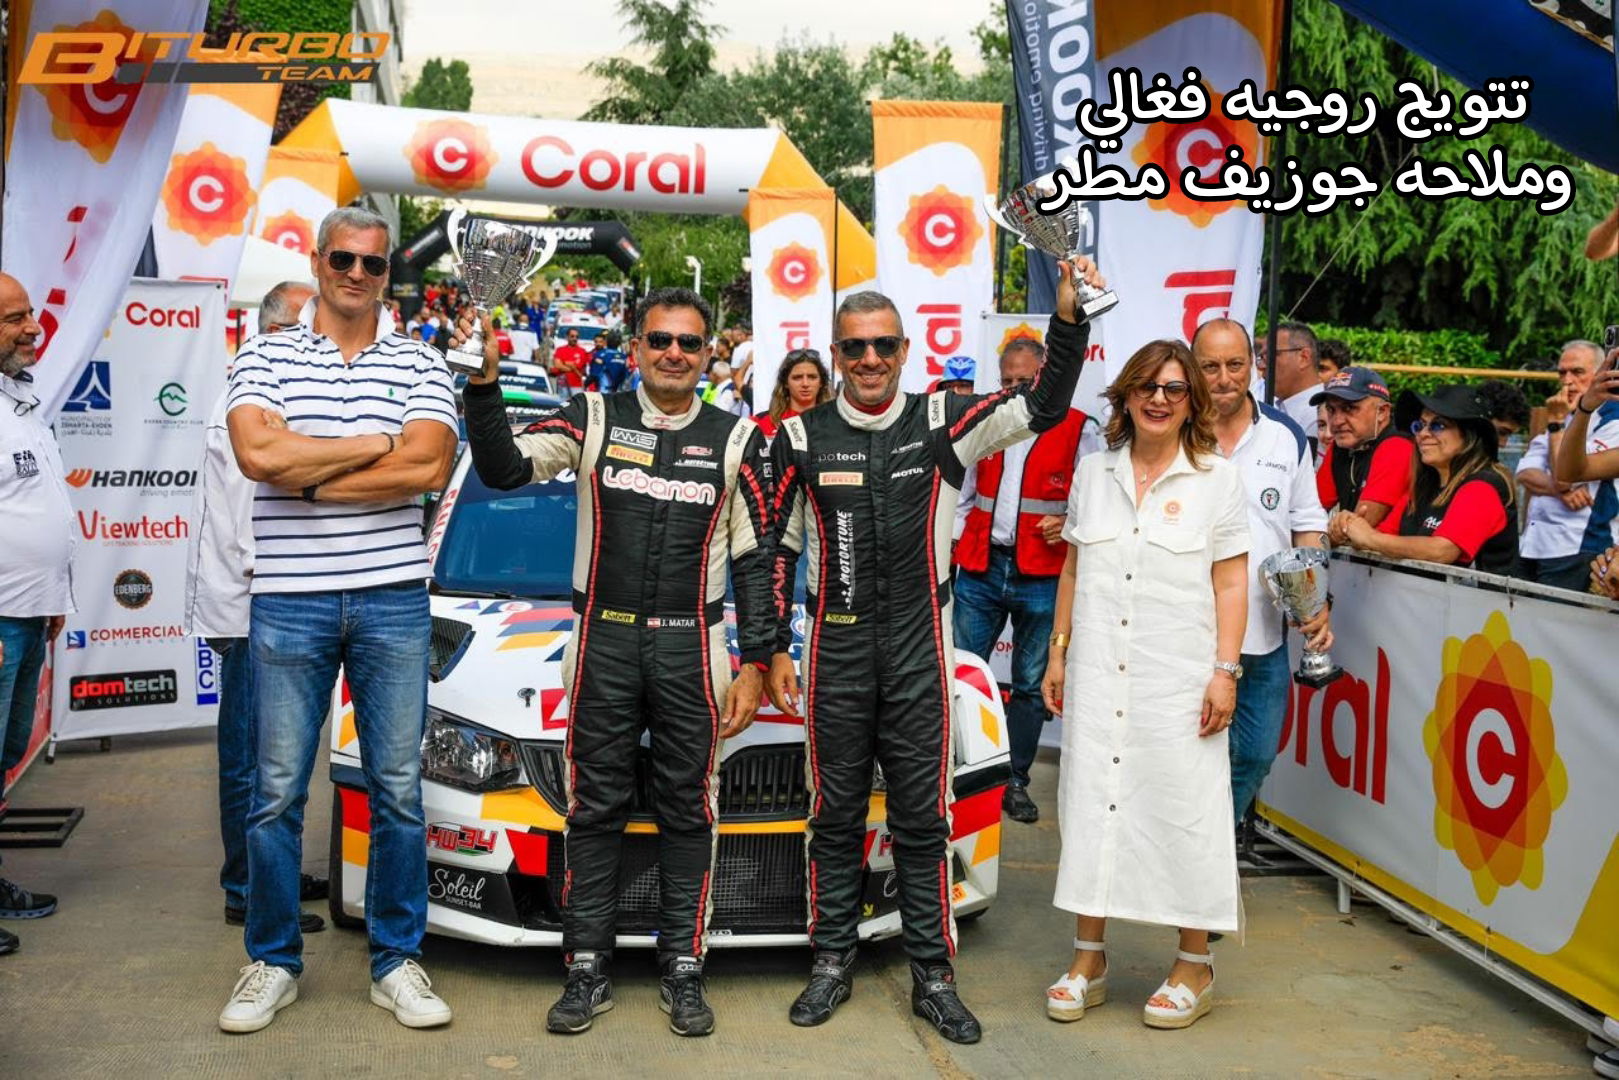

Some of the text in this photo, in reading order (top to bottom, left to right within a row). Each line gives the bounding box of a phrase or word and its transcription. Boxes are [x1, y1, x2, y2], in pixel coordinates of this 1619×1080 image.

[521, 135, 706, 195] Coral
[126, 301, 201, 329] Coral
[602, 465, 716, 505] Lebanon
[891, 467, 925, 479] MOTUL
[78, 510, 188, 540] Viewtech
[836, 510, 851, 586] MOTORTUNE
[90, 625, 185, 641] COMMERCIAL
[669, 619, 695, 627] MATAR
[73, 674, 174, 699] domtech
[427, 868, 486, 901] Soleil
